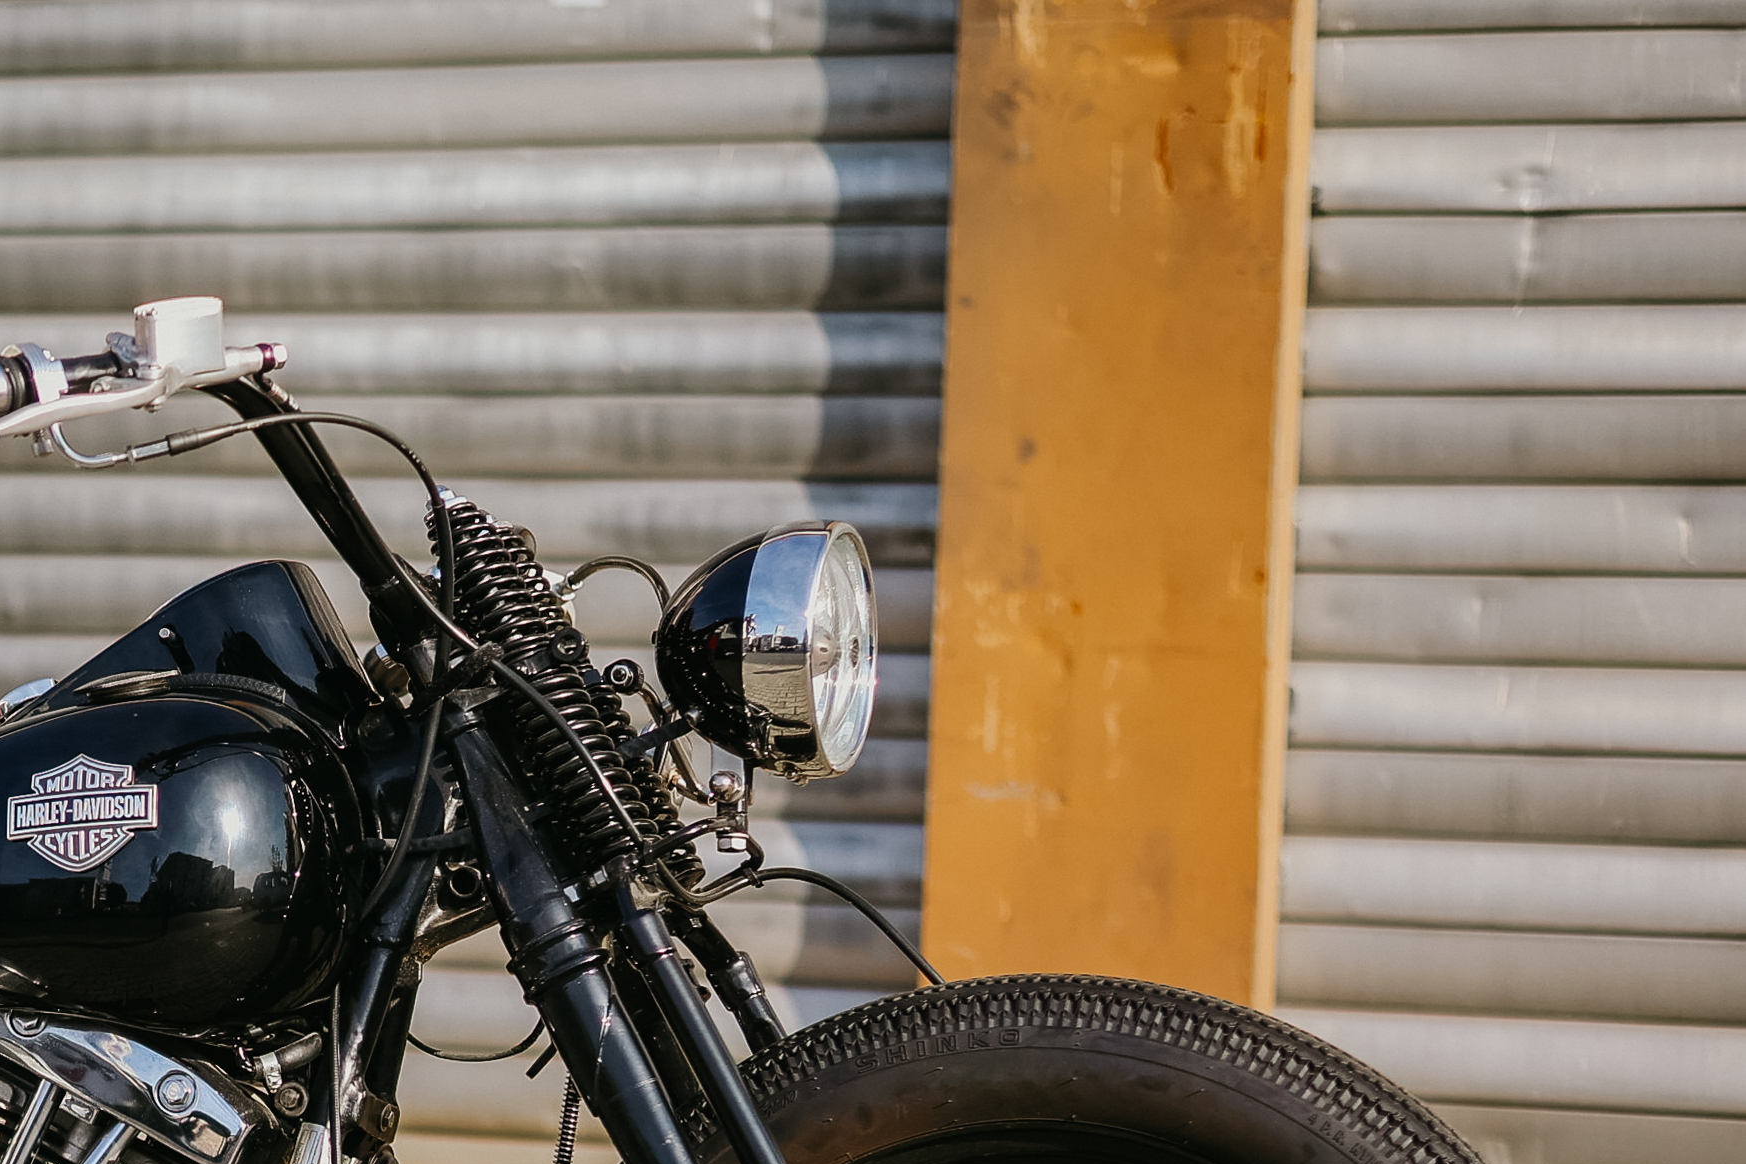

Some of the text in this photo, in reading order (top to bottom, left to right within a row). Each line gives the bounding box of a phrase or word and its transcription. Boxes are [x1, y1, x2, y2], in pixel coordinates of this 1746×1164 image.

[46, 764, 115, 793] MOTOR
[16, 795, 146, 828] HARLEY-DAVIDSON
[44, 828, 114, 861] CYCLES
[855, 1029, 1021, 1074] SHINKO
